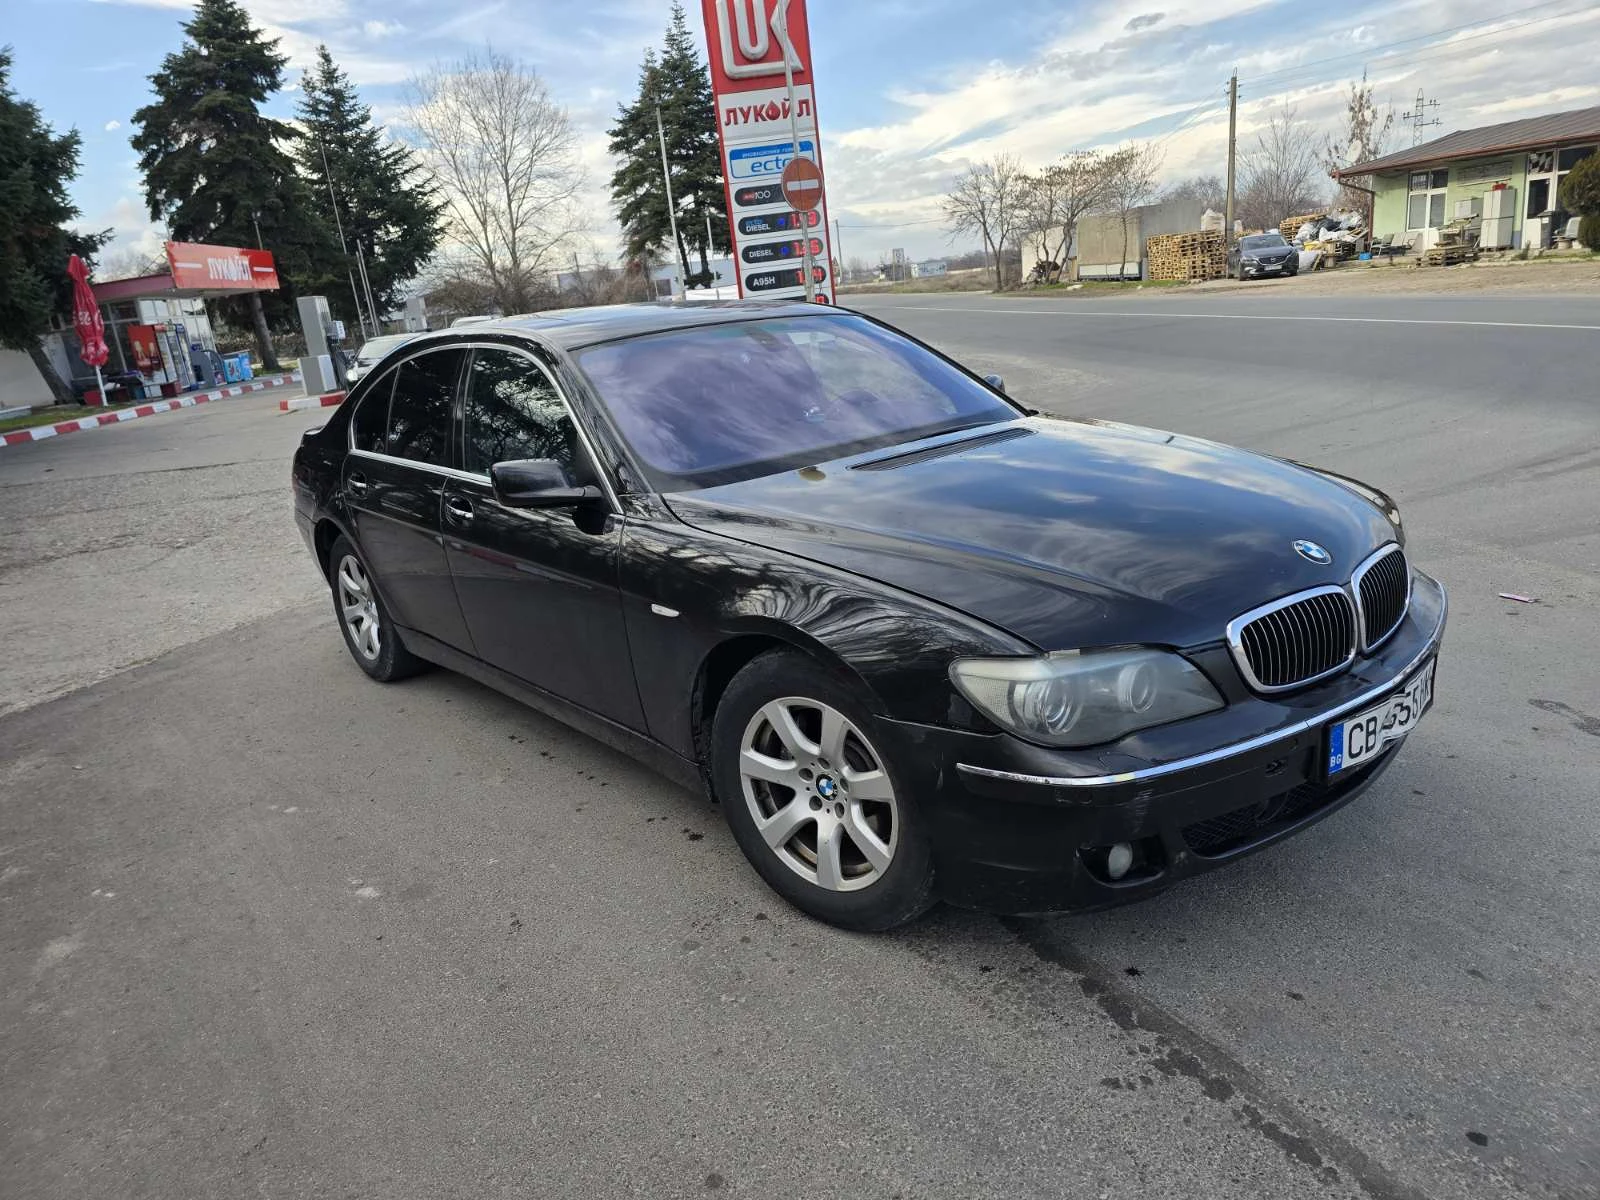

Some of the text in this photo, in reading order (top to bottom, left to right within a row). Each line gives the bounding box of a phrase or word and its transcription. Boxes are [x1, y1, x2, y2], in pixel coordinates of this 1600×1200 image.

[746, 223, 771, 233] DIESEL
[749, 249, 774, 258] DIESEL
[1330, 754, 1342, 768] BG
